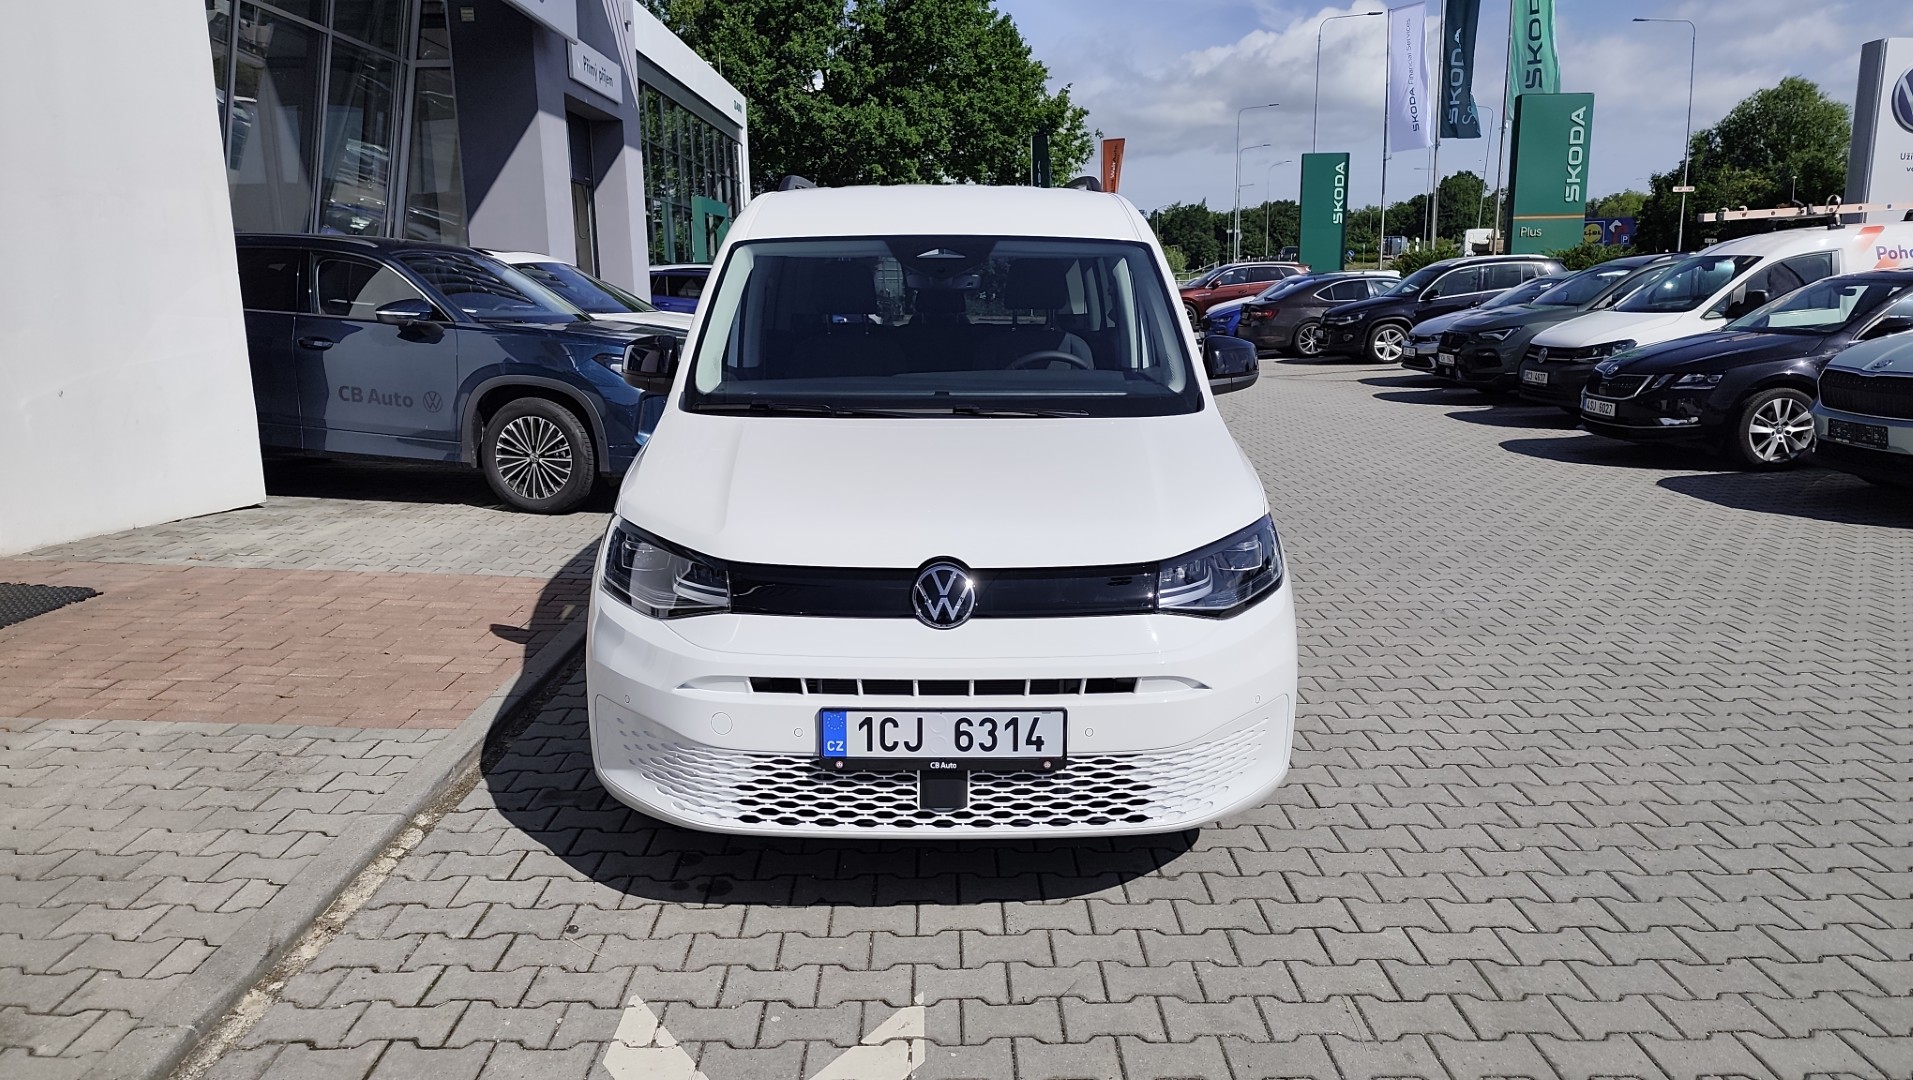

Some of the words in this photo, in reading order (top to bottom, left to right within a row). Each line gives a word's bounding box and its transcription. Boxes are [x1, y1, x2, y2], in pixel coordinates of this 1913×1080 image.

[1520, 226, 1543, 238] Plus
[338, 385, 364, 402] CB
[368, 388, 414, 408] Auto
[858, 716, 924, 752] 1CJ
[954, 716, 1045, 752] 6314
[827, 740, 844, 752] CZ
[930, 761, 939, 769] CB
[940, 761, 957, 769] Auto
